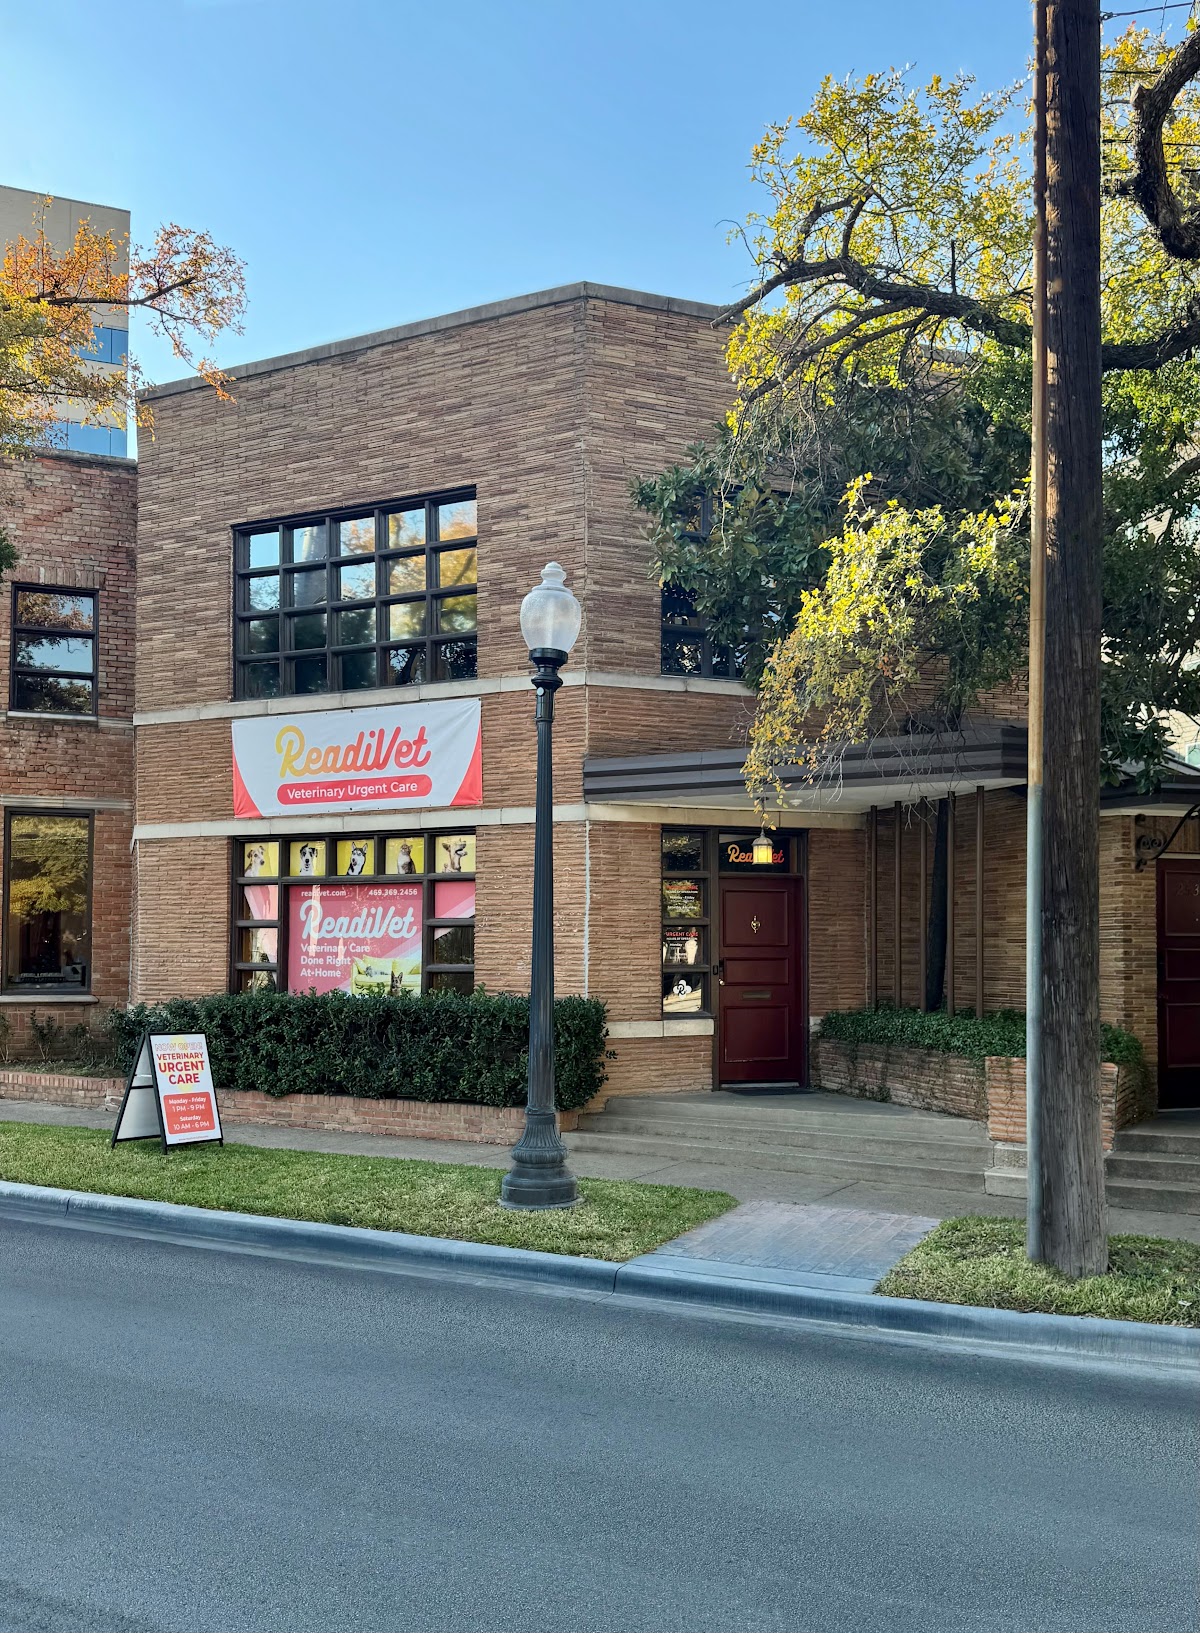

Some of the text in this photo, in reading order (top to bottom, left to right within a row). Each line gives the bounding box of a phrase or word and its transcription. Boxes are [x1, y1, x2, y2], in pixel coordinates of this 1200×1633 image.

[275, 725, 432, 778] ReadiVet
[287, 781, 418, 799] Veterinary Urgent Care
[727, 844, 785, 863] Reaet
[368, 888, 418, 896] 469.369.2456
[300, 899, 417, 939] ReadiVet
[349, 943, 371, 953] Care
[300, 956, 351, 967] Done Right
[300, 967, 341, 977] At-Home
[154, 1042, 177, 1052] NOW
[156, 1052, 204, 1060] VETERINARY
[158, 1060, 205, 1073] URGENT
[168, 1073, 200, 1085] CARE
